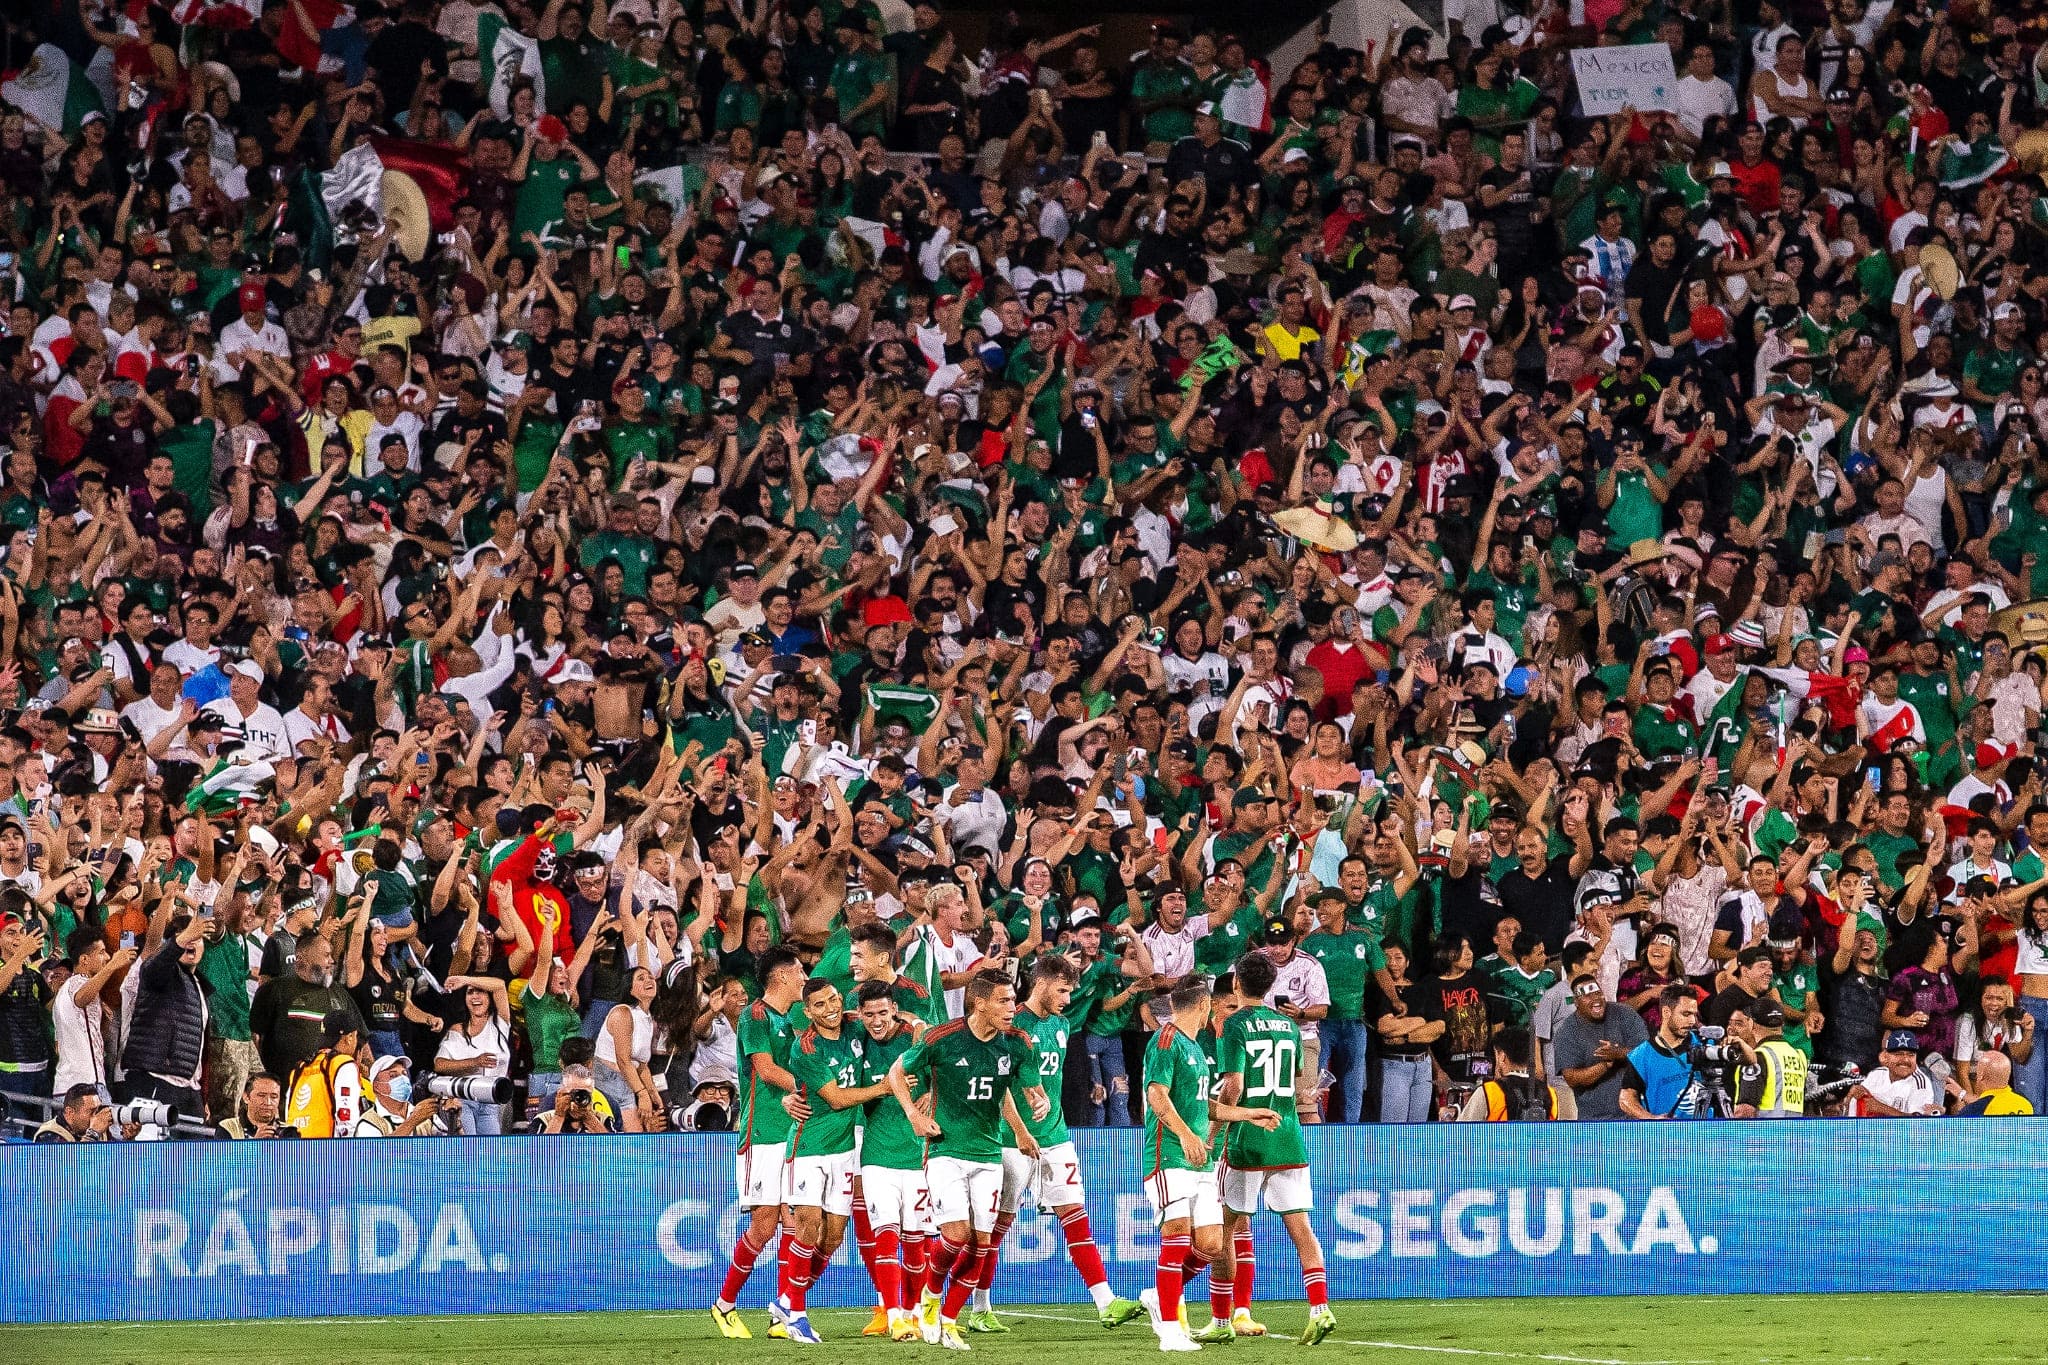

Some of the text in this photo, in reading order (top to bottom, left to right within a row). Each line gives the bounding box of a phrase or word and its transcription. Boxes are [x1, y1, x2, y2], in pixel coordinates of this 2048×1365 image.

[1442, 986, 1479, 1012] SLAYER
[837, 1063, 857, 1089] 31
[1040, 1051, 1060, 1076] 29
[1245, 1039, 1296, 1098] 30
[966, 1076, 994, 1100] 15
[134, 1187, 509, 1278] RÁPIDA.
[1334, 1185, 1719, 1260] SEGURA.
